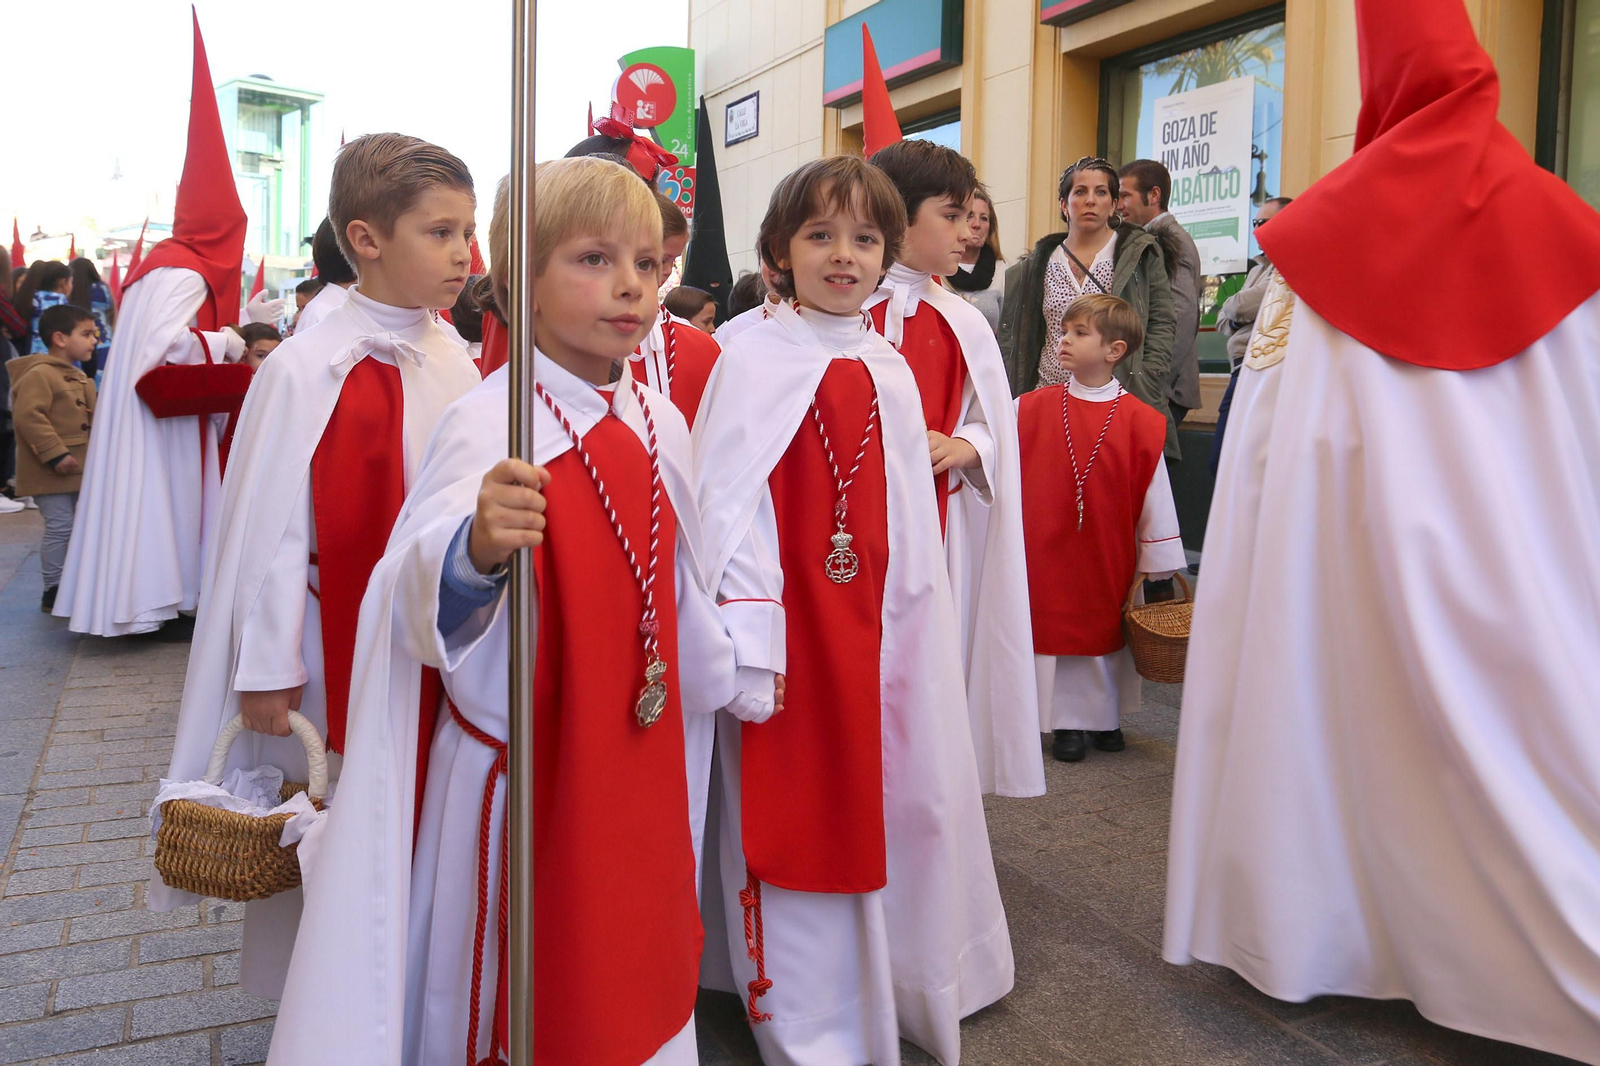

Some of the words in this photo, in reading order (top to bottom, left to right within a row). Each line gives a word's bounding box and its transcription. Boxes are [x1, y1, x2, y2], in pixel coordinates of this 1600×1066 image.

[1162, 115, 1197, 145] GOZA
[1200, 110, 1218, 138] DE
[671, 138, 689, 160] 24
[1161, 147, 1179, 172] UN
[1181, 140, 1210, 170] AÑO
[1169, 168, 1241, 208] ABÁTICO
